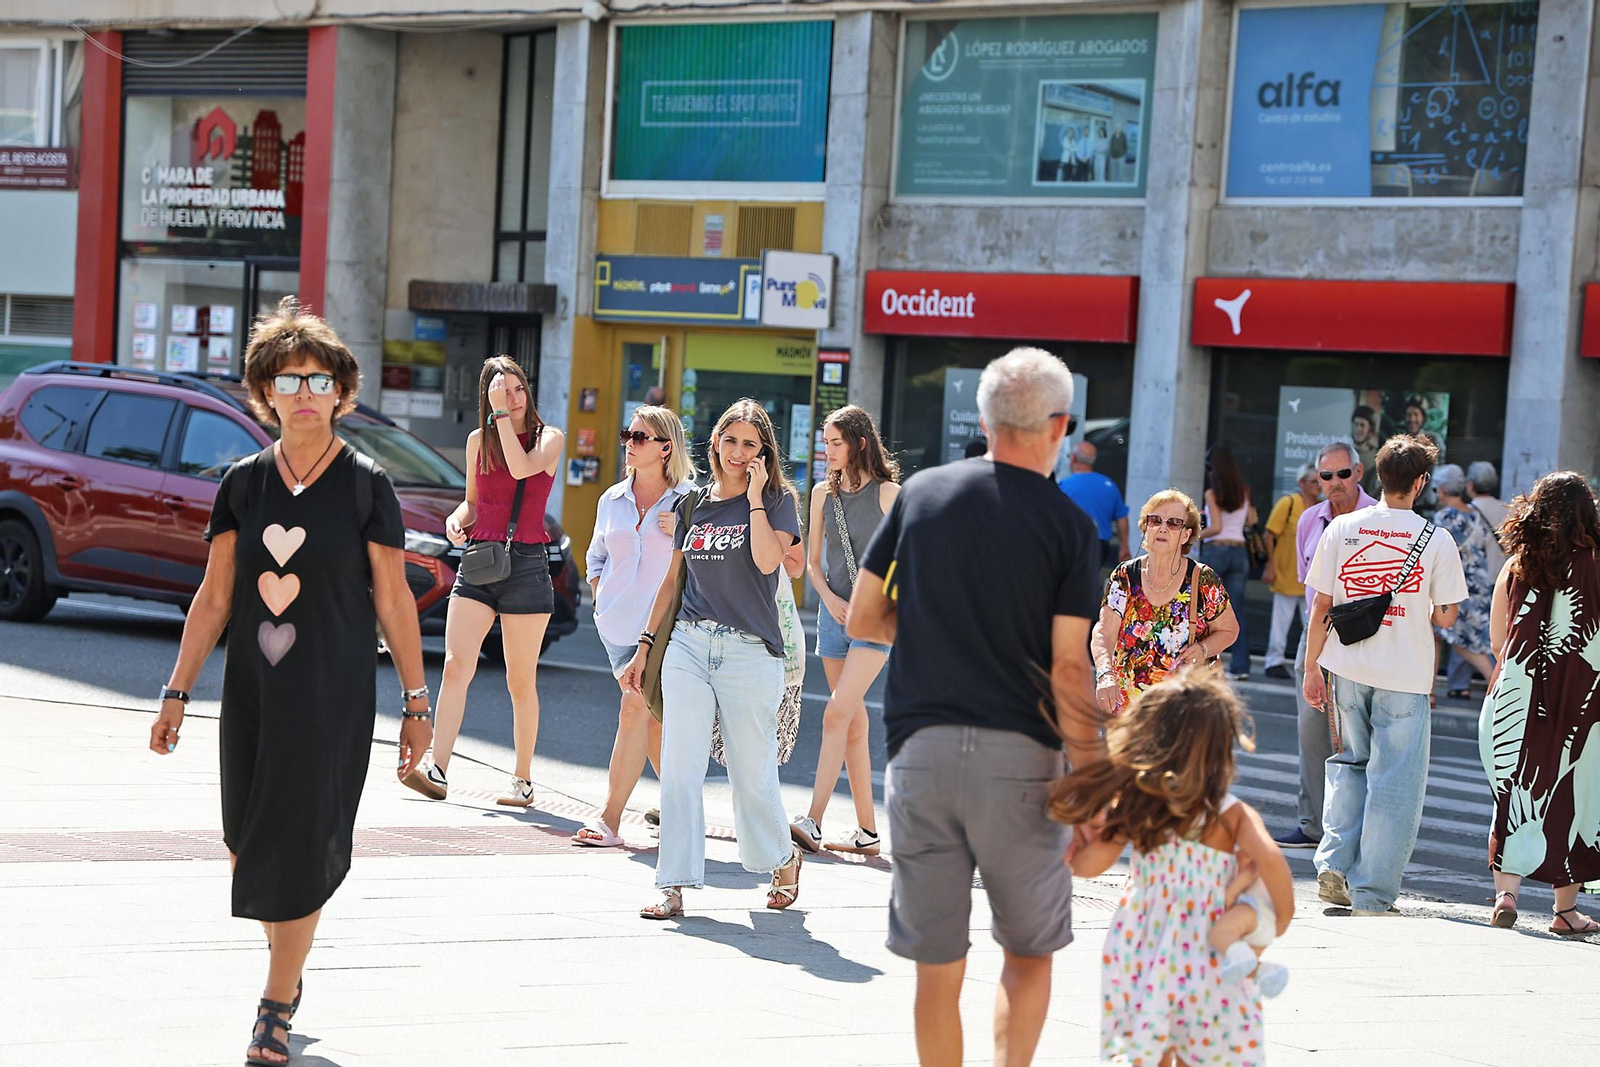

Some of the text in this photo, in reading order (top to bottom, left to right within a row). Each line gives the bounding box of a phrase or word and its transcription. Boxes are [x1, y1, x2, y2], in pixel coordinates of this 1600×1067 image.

[965, 40, 1003, 57] LÓPEZ
[1005, 38, 1075, 56] RODRÍGUEZ
[1079, 39, 1149, 55] ABOGADOS
[1257, 71, 1342, 109] alfa
[652, 95, 664, 113] TE
[716, 94, 728, 113] EL
[141, 166, 214, 185] CMARA DE
[141, 187, 285, 208] LA PROPIEDAD URBANA
[141, 208, 158, 226] DE
[160, 208, 208, 228] HUELVA
[881, 288, 976, 318] Occident
[1358, 527, 1412, 539] loved by locals
[1400, 549, 1420, 577] NEVER
[1414, 529, 1432, 552] LOOK
